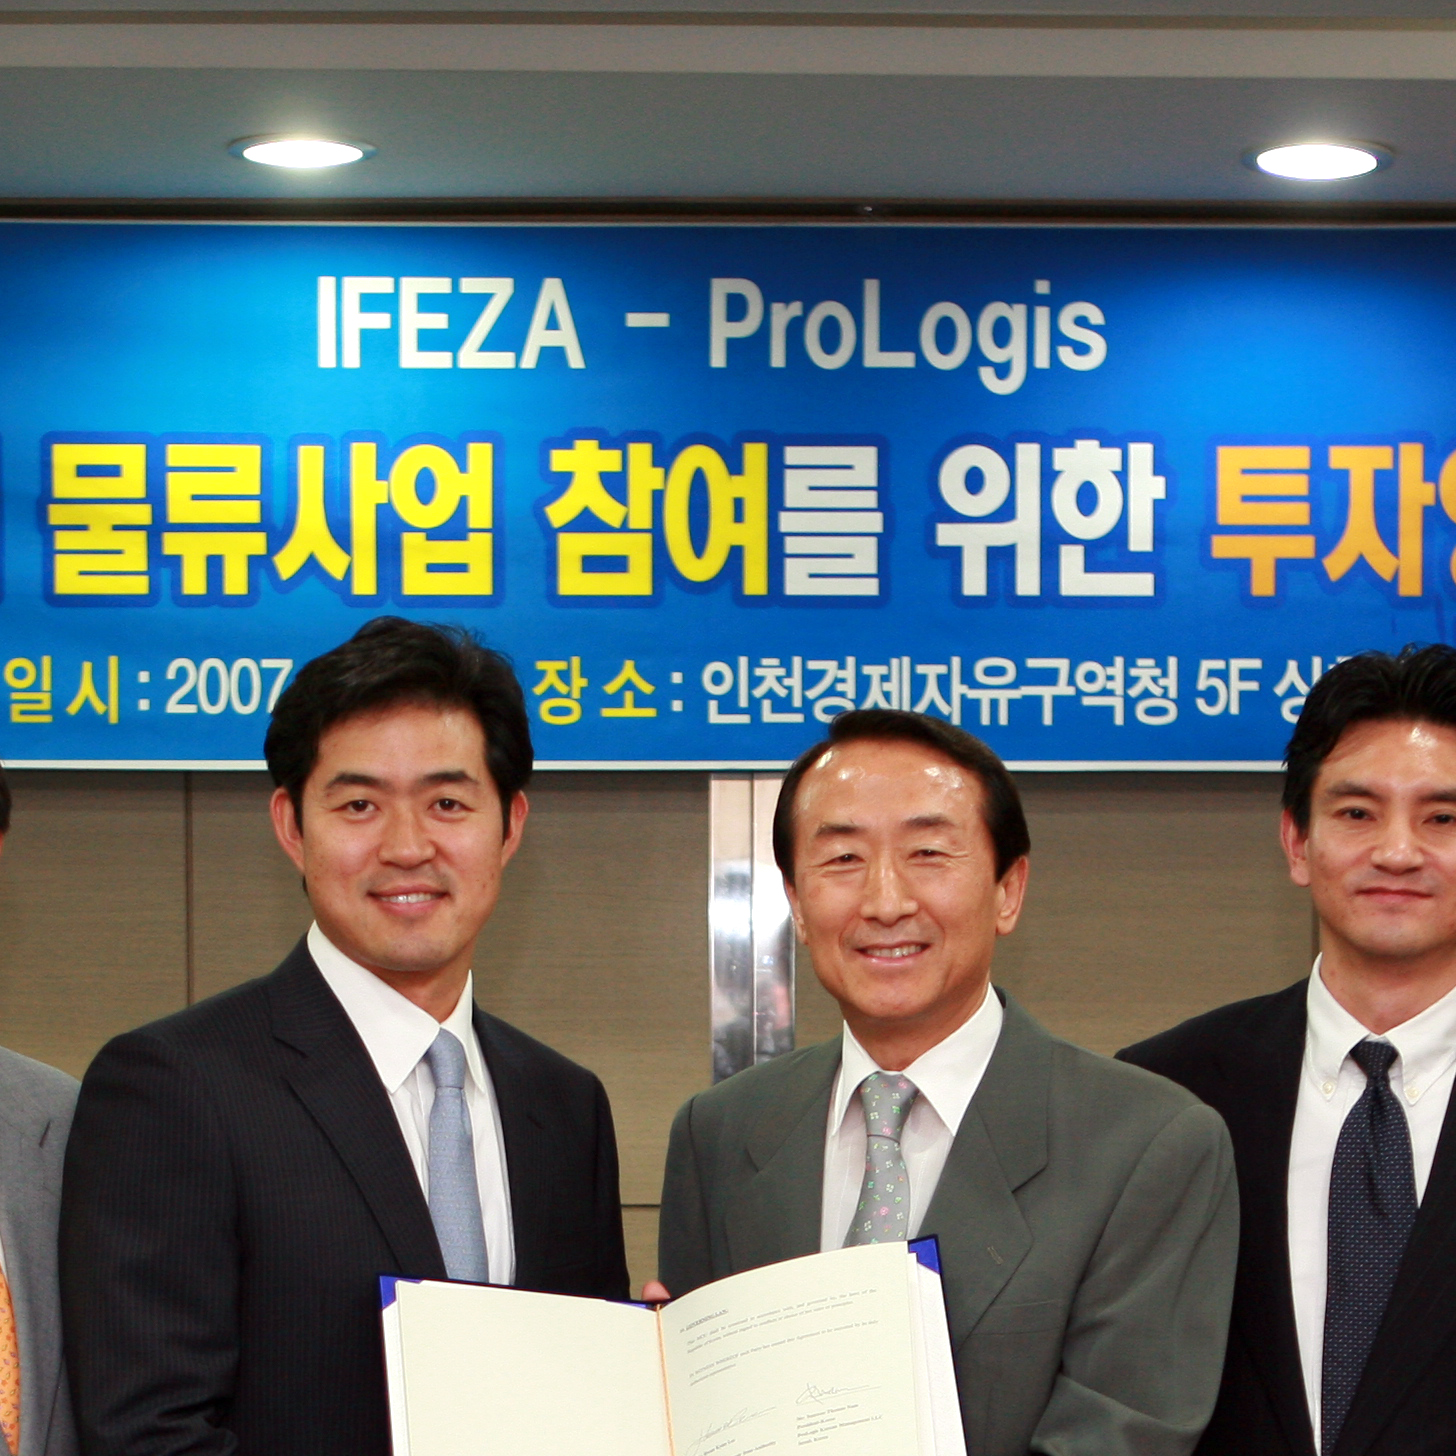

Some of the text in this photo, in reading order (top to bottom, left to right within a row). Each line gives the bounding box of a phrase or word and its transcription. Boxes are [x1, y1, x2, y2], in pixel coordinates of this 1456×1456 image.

[316, 275, 585, 370] IFEZA
[709, 277, 1107, 396] ProLogis
[47, 440, 494, 598] 물류사업
[545, 438, 884, 598] 참여를
[936, 440, 1166, 598] 위한
[701, 655, 1179, 726] 인천경제자유구역청
[1195, 658, 1262, 716] 5F
[1273, 655, 1352, 724] 상
